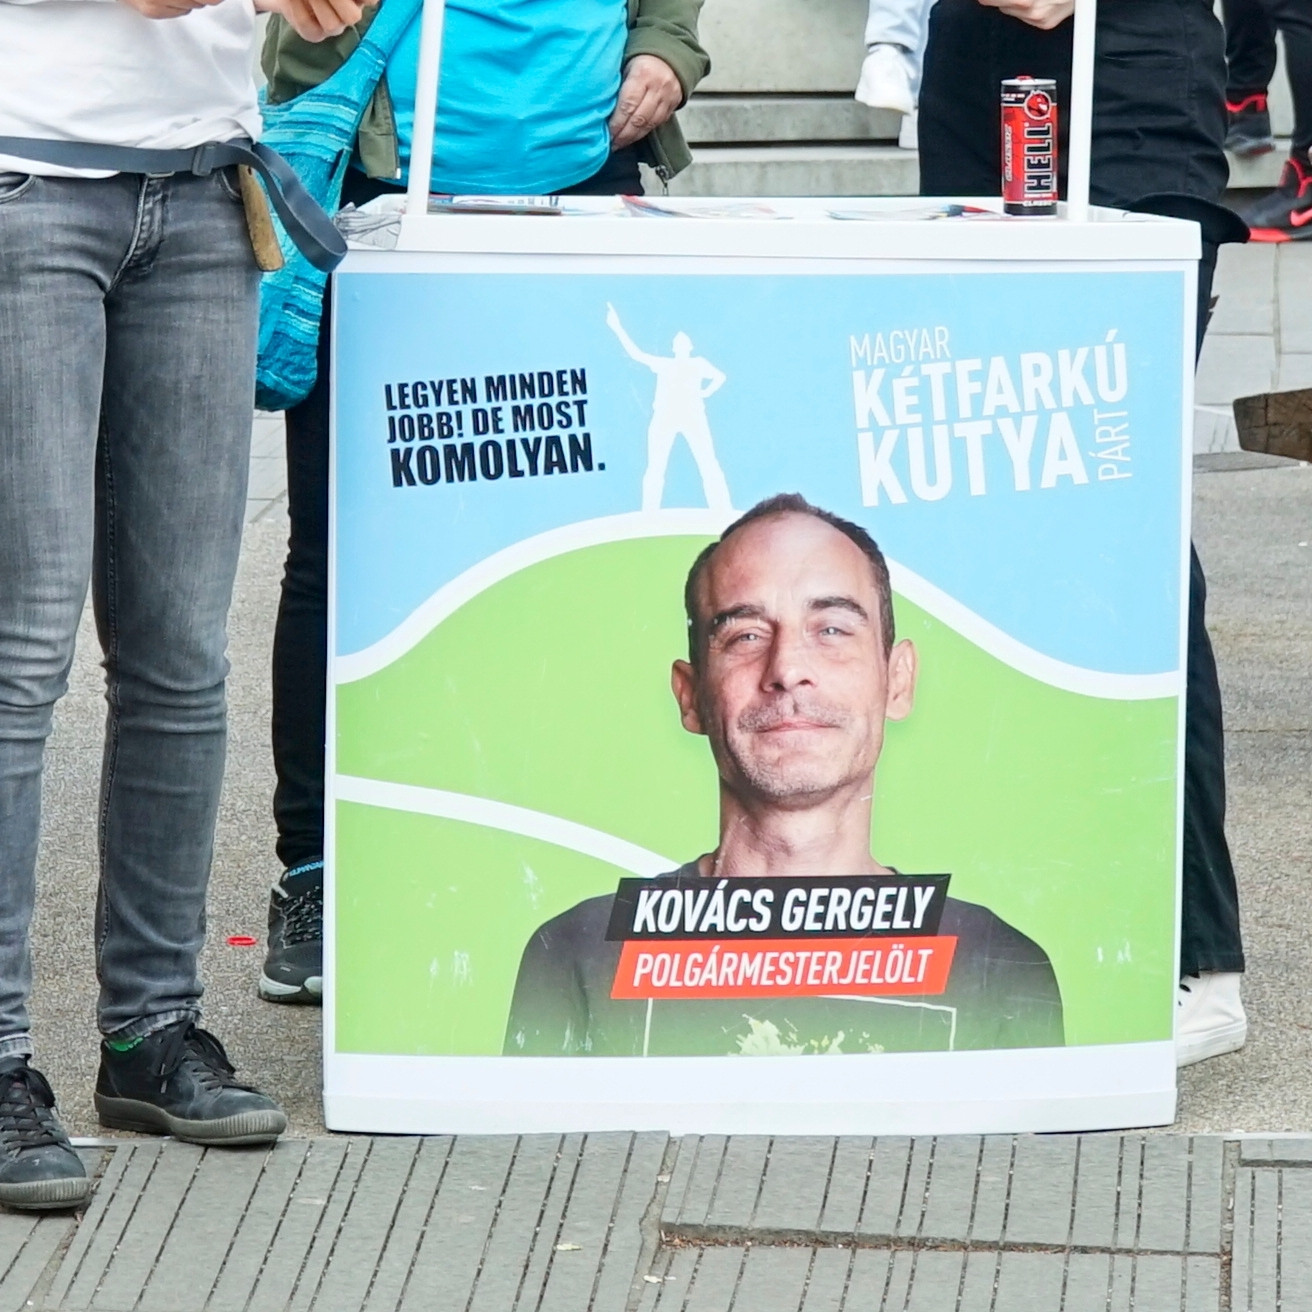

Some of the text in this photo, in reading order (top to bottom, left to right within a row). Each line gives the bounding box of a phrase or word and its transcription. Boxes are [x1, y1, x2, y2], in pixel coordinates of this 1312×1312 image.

[1023, 122, 1053, 193] HELL
[849, 326, 950, 366] MAGYAR
[385, 368, 588, 412] LEGYEN MINDEN
[853, 329, 1129, 430] KÉTFARKÚ
[387, 399, 588, 444] JOBB! DE MOST
[390, 433, 606, 489] KOMOLYAN.
[857, 407, 1135, 508] KUTYA PÁRT
[632, 879, 935, 933] KOVÁCS GERGELY
[632, 944, 933, 988] POLGÁRMESTERJELÖLT
